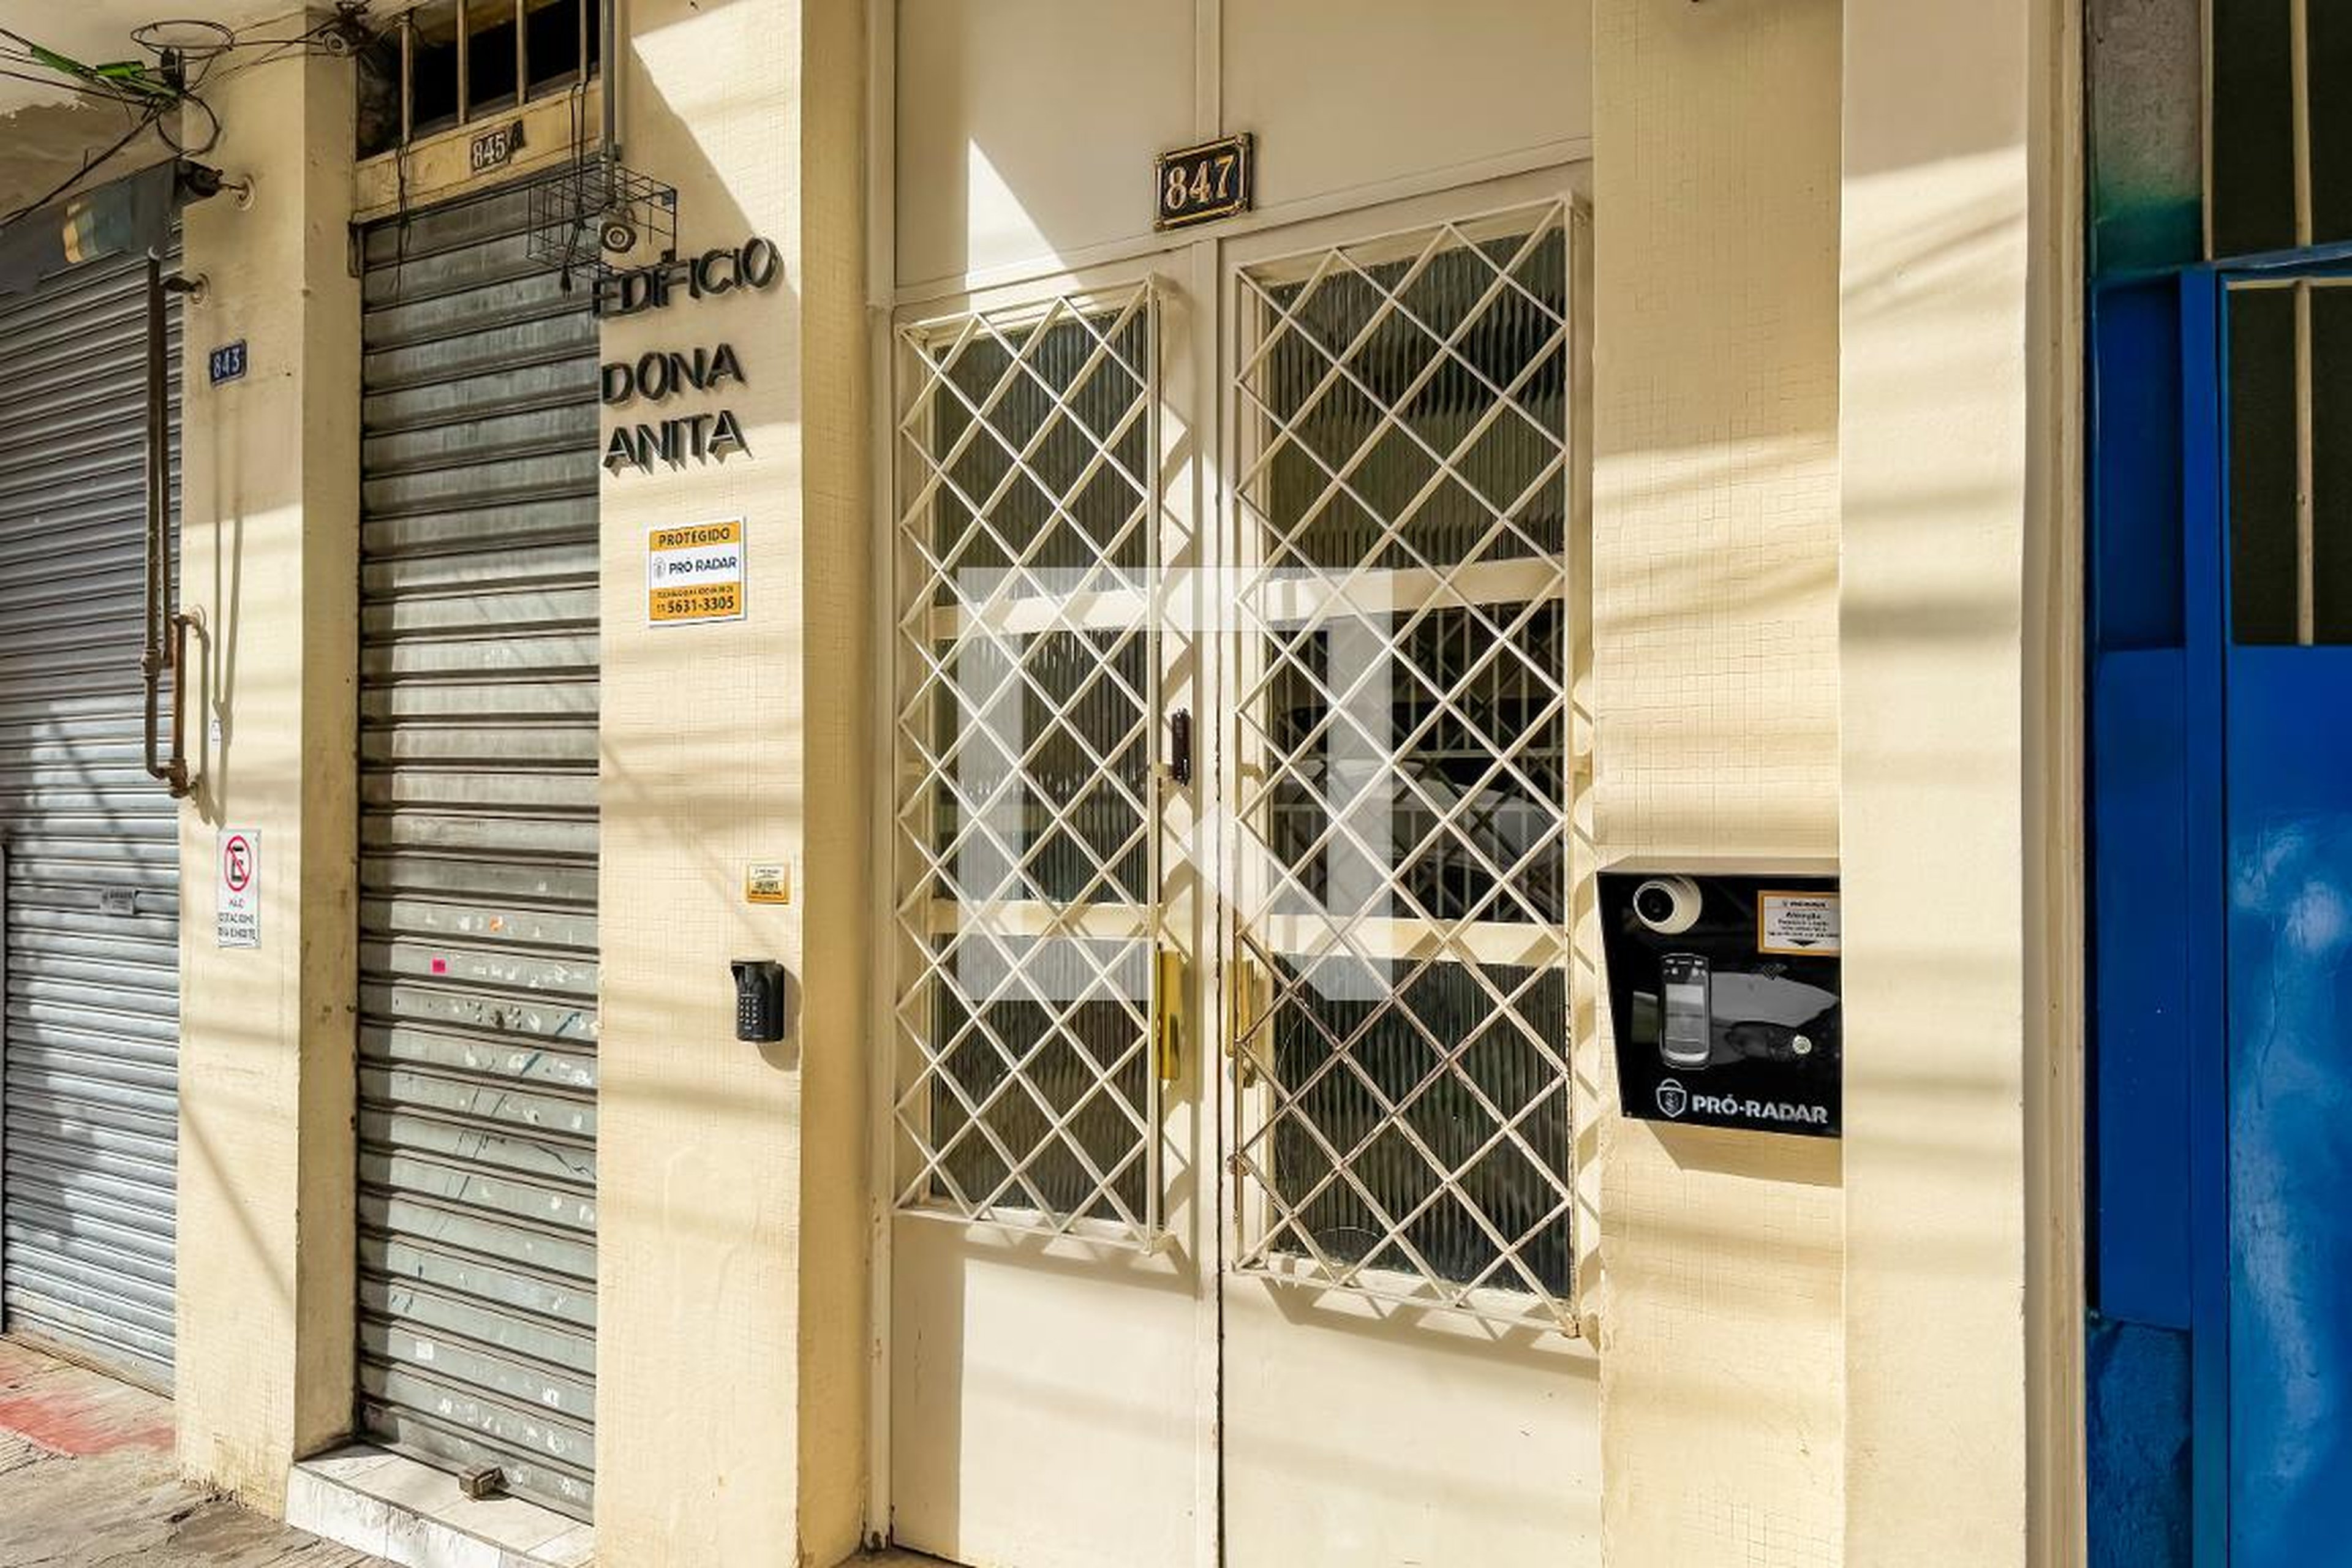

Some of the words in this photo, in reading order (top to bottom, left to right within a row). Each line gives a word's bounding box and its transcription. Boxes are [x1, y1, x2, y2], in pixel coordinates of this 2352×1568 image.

[473, 133, 505, 168] 845
[1166, 154, 1234, 209] 847
[214, 347, 239, 378] 843
[602, 343, 748, 405] DONA
[603, 410, 753, 473] ANITA
[658, 527, 730, 546] PROTEGIDO
[695, 556, 737, 573] RADAR
[668, 595, 734, 613] 5631-3305
[1692, 1093, 1828, 1124] PRÓ-RADAR
